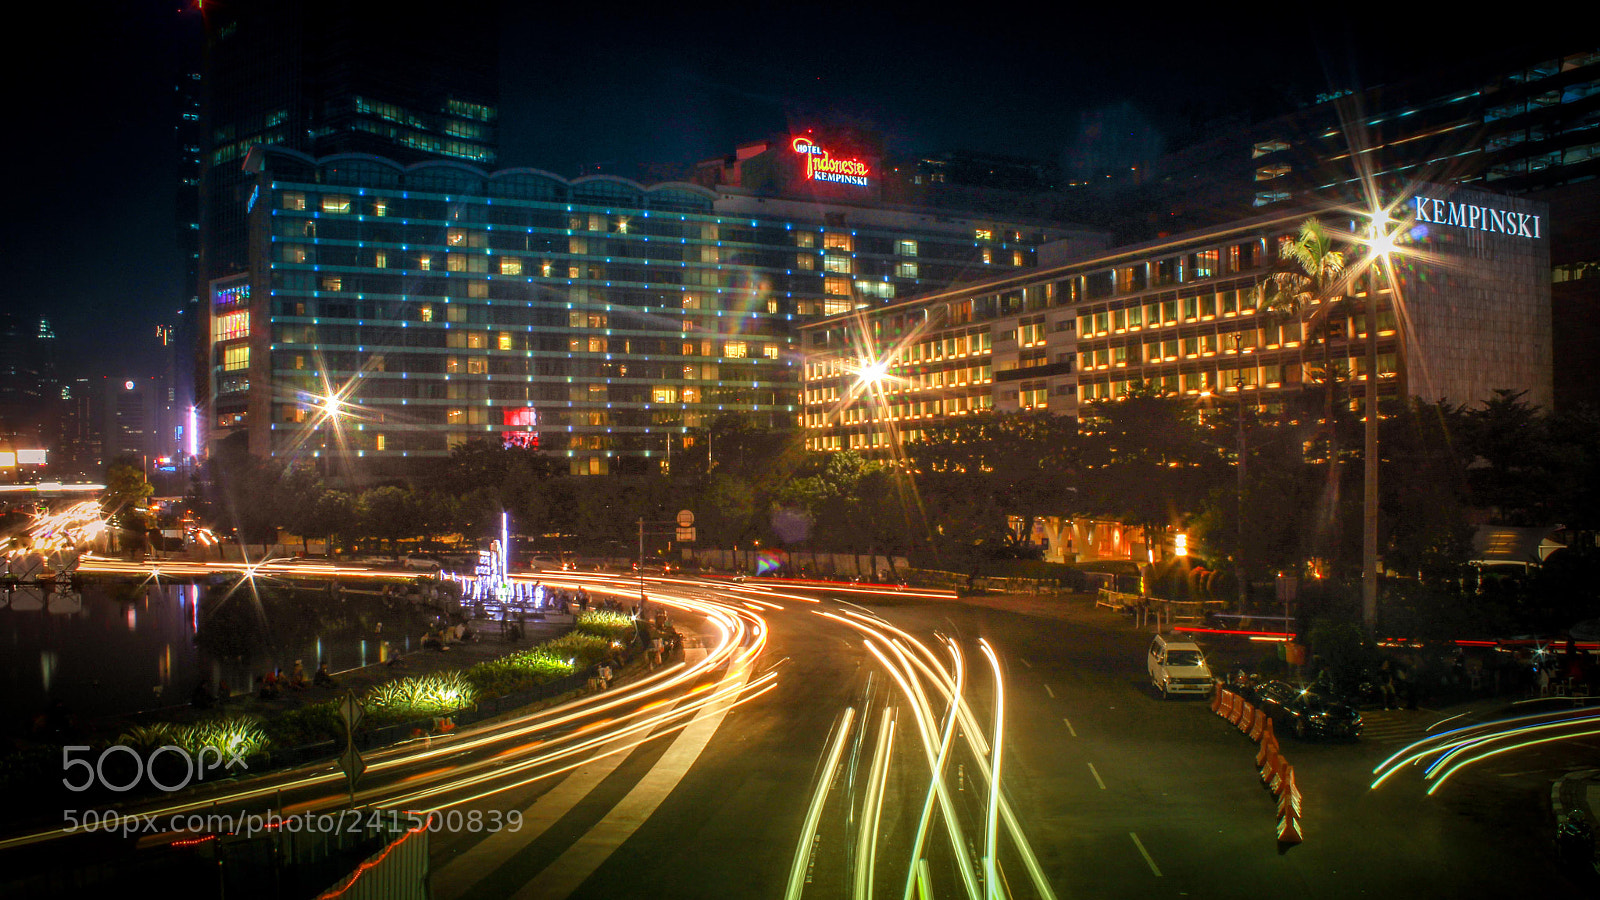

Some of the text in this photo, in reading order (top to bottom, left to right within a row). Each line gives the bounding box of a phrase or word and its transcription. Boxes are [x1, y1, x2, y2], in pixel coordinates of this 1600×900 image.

[793, 138, 869, 179] Indonesia
[797, 144, 823, 155] HOTEL
[814, 171, 868, 187] KEMPINSKI
[1414, 196, 1541, 239] KEMPINSKI
